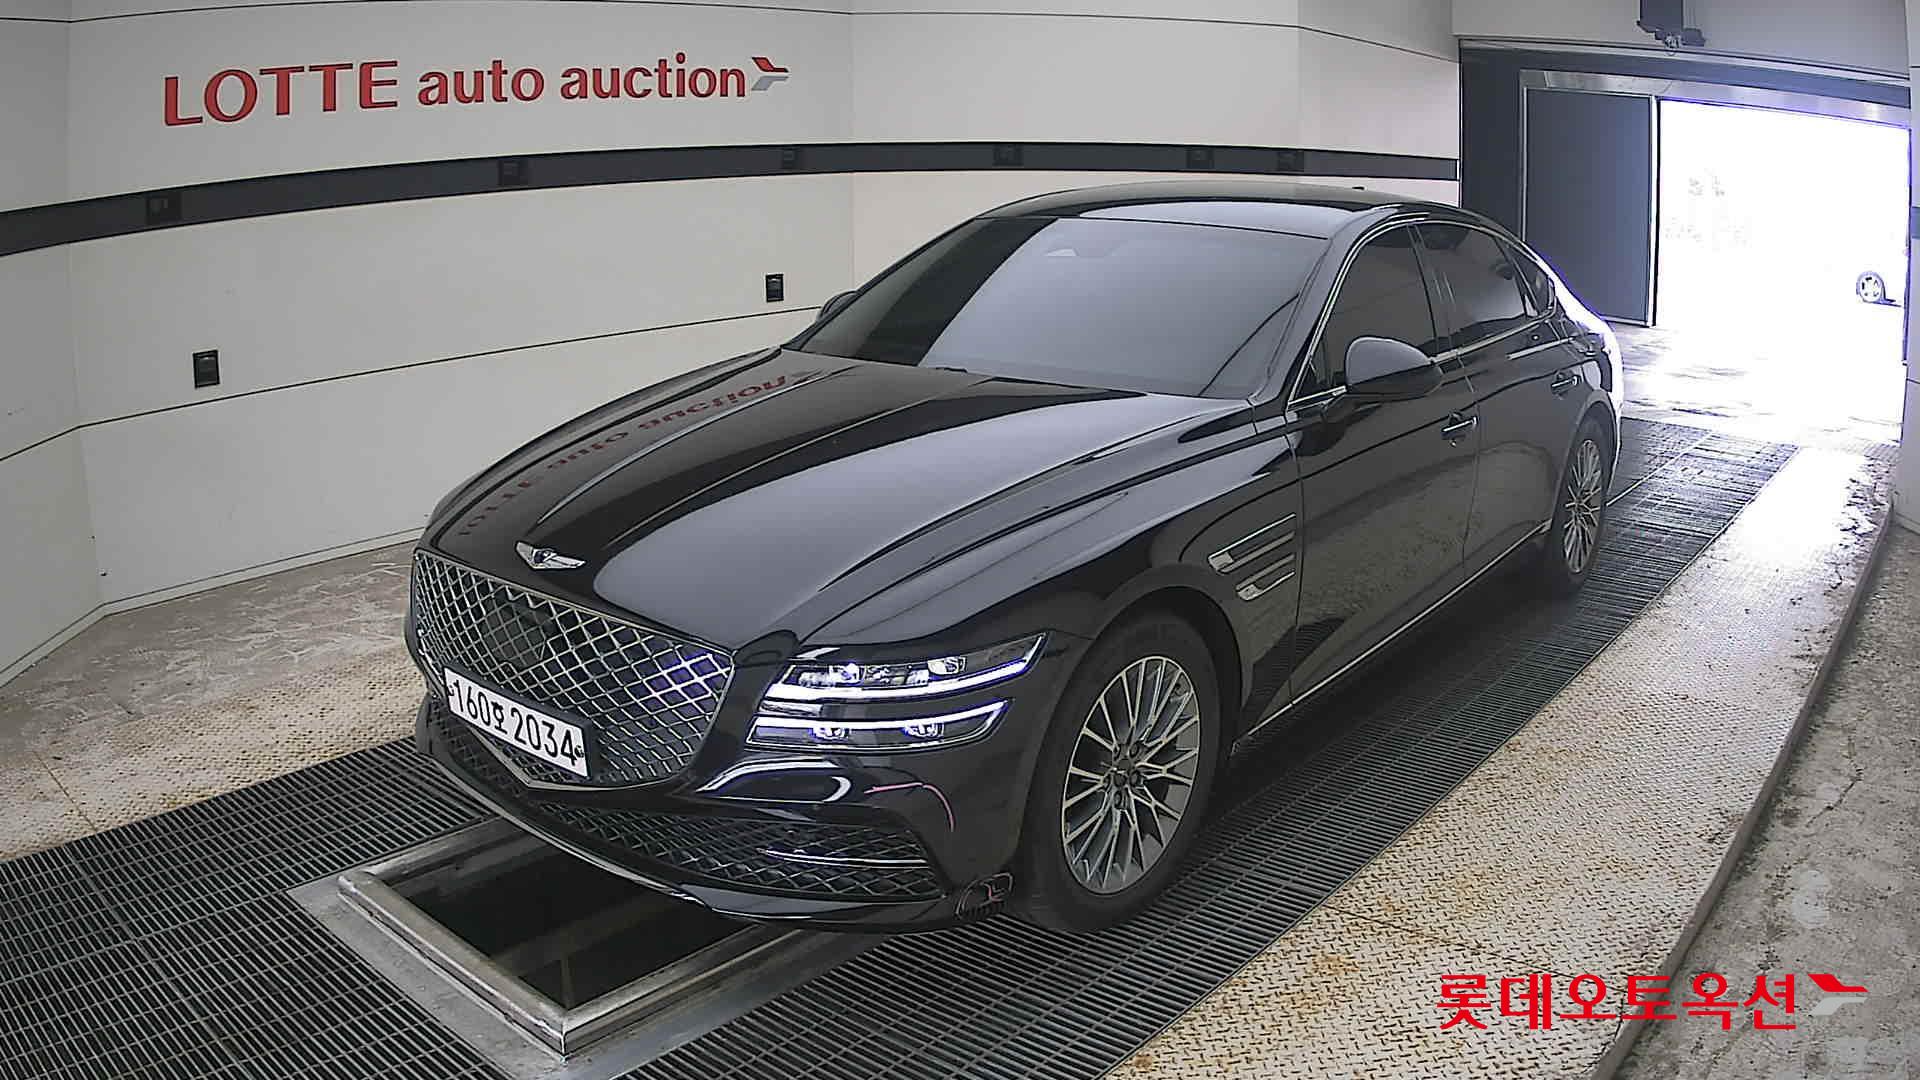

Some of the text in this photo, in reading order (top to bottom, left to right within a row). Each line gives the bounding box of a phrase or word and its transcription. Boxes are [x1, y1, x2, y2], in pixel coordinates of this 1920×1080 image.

[163, 53, 748, 127] LOTTE auto auction
[453, 679, 578, 766] 160호 2034
